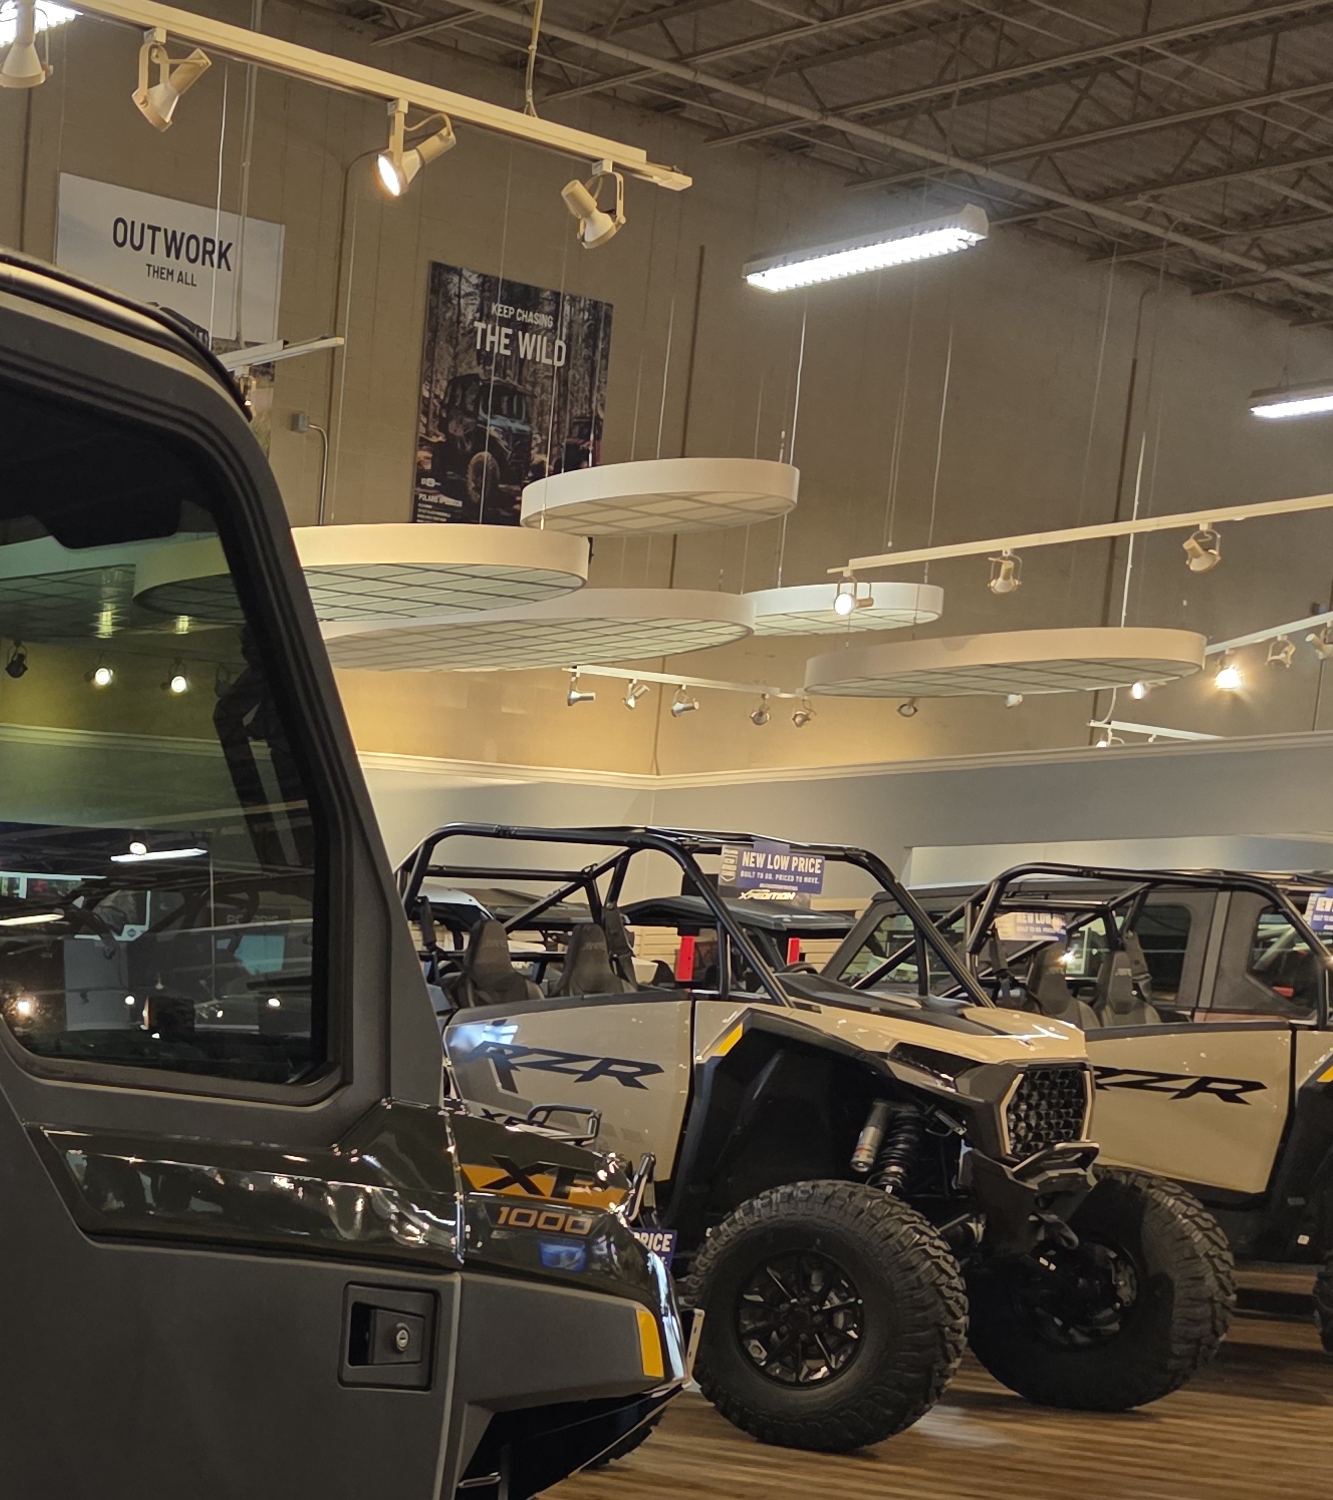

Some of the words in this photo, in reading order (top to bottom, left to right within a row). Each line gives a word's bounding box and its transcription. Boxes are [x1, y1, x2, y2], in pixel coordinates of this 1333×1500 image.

[113, 217, 233, 272] OUTWORK
[145, 263, 174, 282] THEM
[177, 270, 197, 287] ALL
[491, 302, 515, 319] KEEP
[516, 308, 553, 328] CHASING
[474, 321, 512, 356] THE
[518, 331, 566, 367] WILD
[740, 870, 755, 878] BUILT
[775, 874, 794, 882] PRICED
[796, 875, 802, 883] TO
[742, 851, 766, 869] NEW
[767, 854, 790, 871] LOW
[791, 856, 823, 874] PRICE
[456, 1040, 665, 1091] RZR
[480, 1154, 605, 1200] XP
[496, 1206, 593, 1235] 1000
